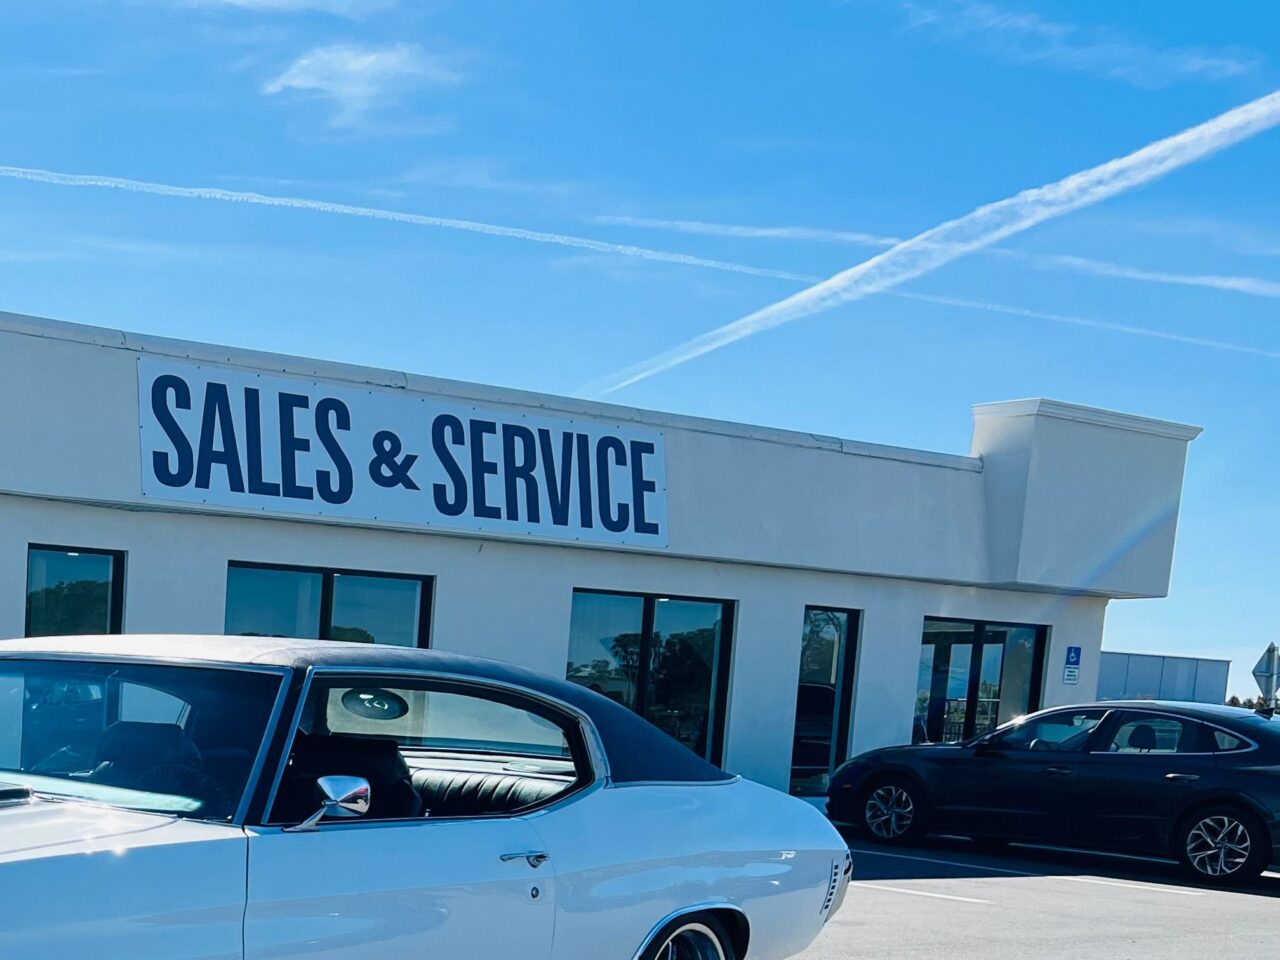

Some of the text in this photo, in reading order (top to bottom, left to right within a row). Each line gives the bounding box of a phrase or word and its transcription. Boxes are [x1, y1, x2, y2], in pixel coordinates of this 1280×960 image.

[150, 374, 659, 535] SALES & SERVICE
